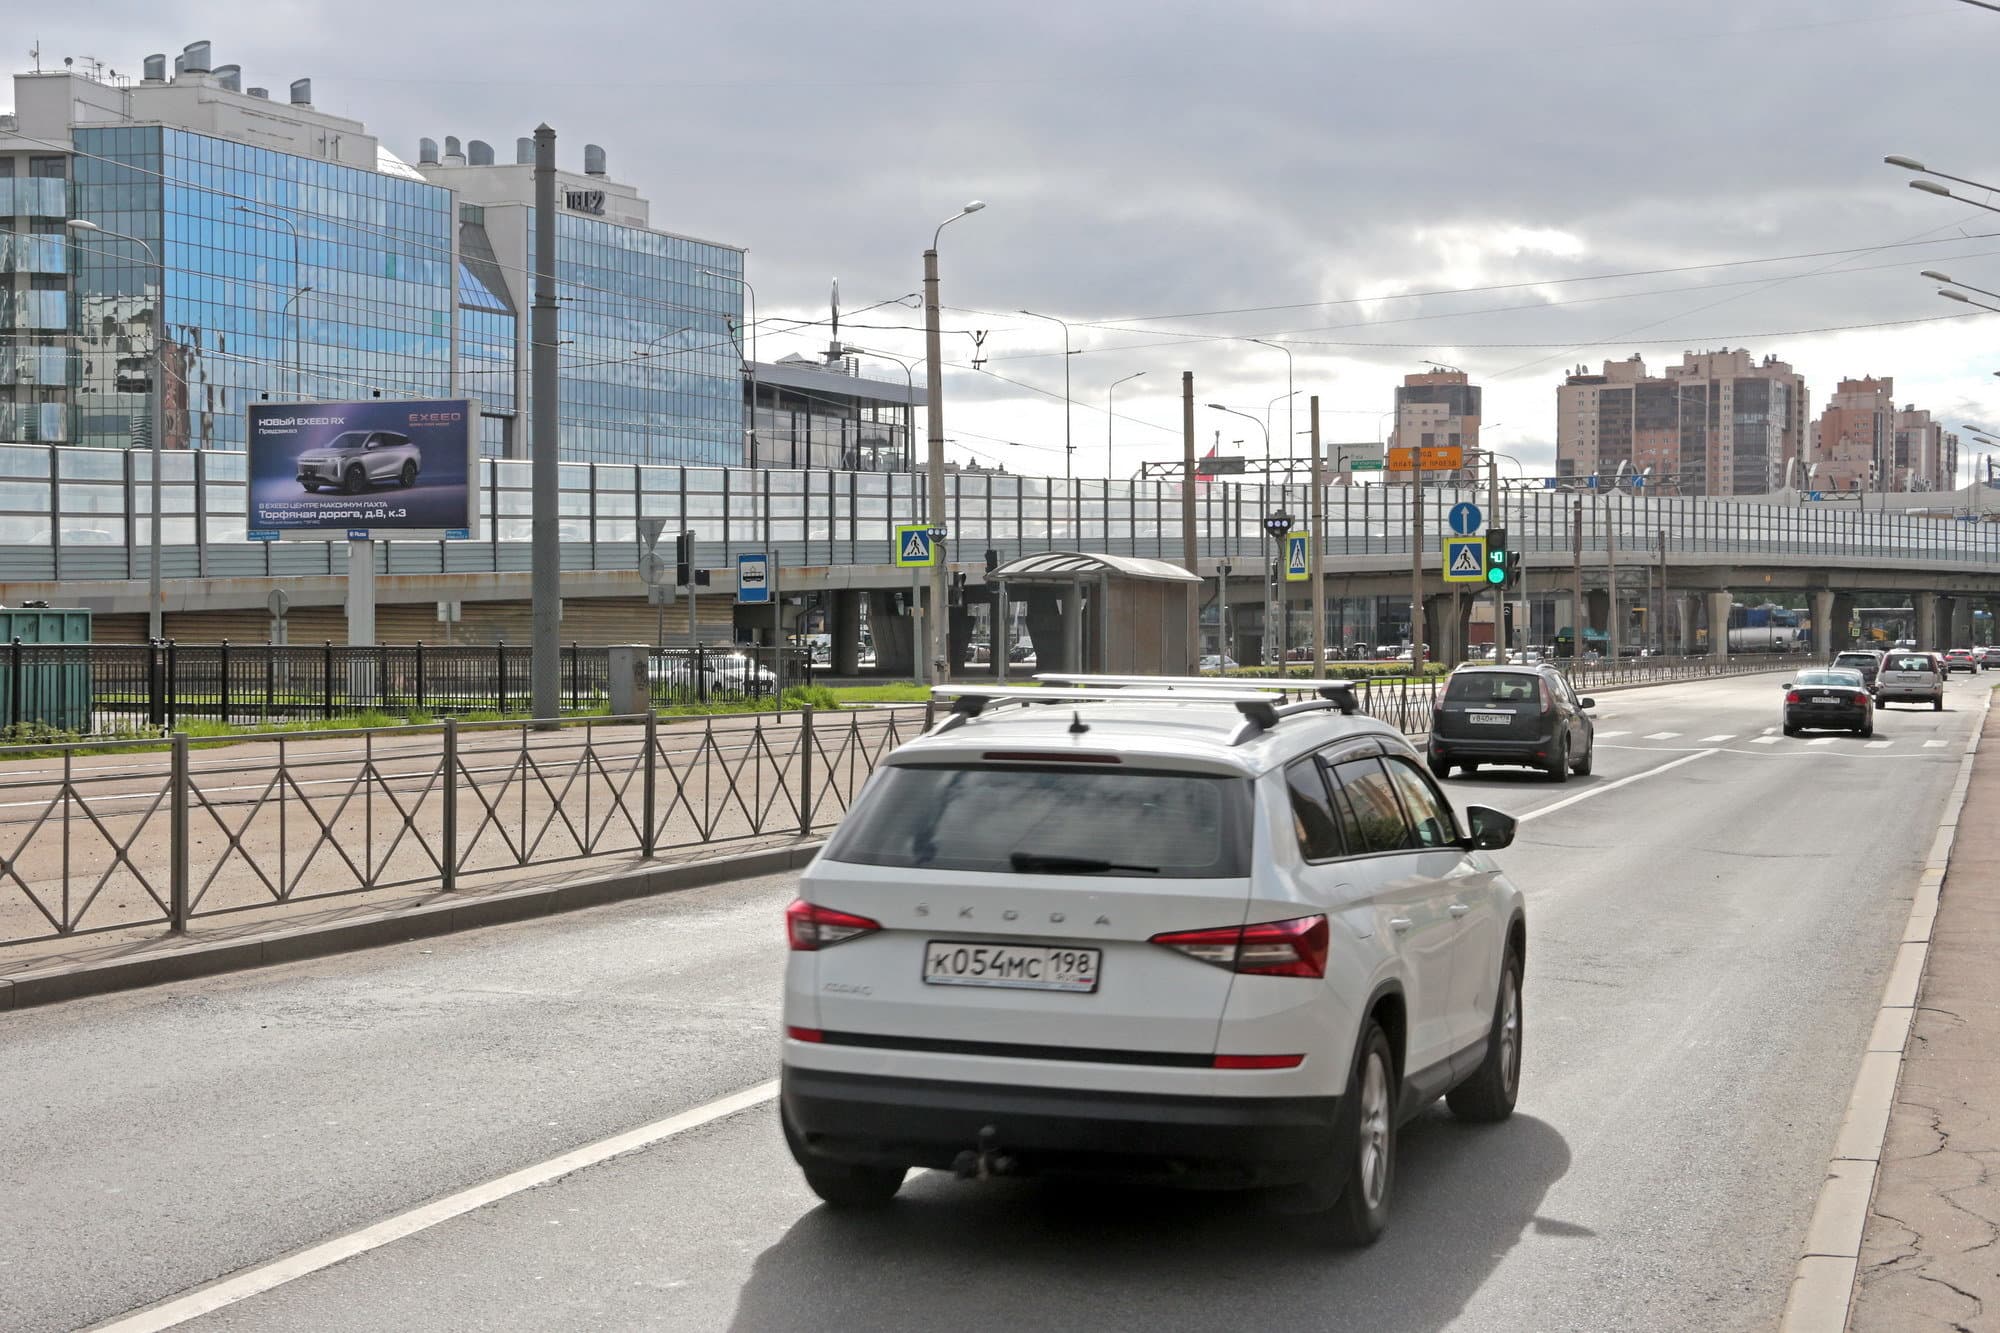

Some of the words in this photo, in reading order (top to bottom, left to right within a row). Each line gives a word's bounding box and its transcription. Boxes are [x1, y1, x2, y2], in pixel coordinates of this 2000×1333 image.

[258, 417, 295, 426] НОВЫЙ
[296, 418, 329, 426] EXEED
[331, 417, 345, 425] RX
[409, 413, 461, 421] EXEED
[259, 510, 317, 520] Торфяная
[318, 511, 363, 520] дорога,
[388, 508, 407, 518] к.3
[1490, 551, 1503, 563] 40
